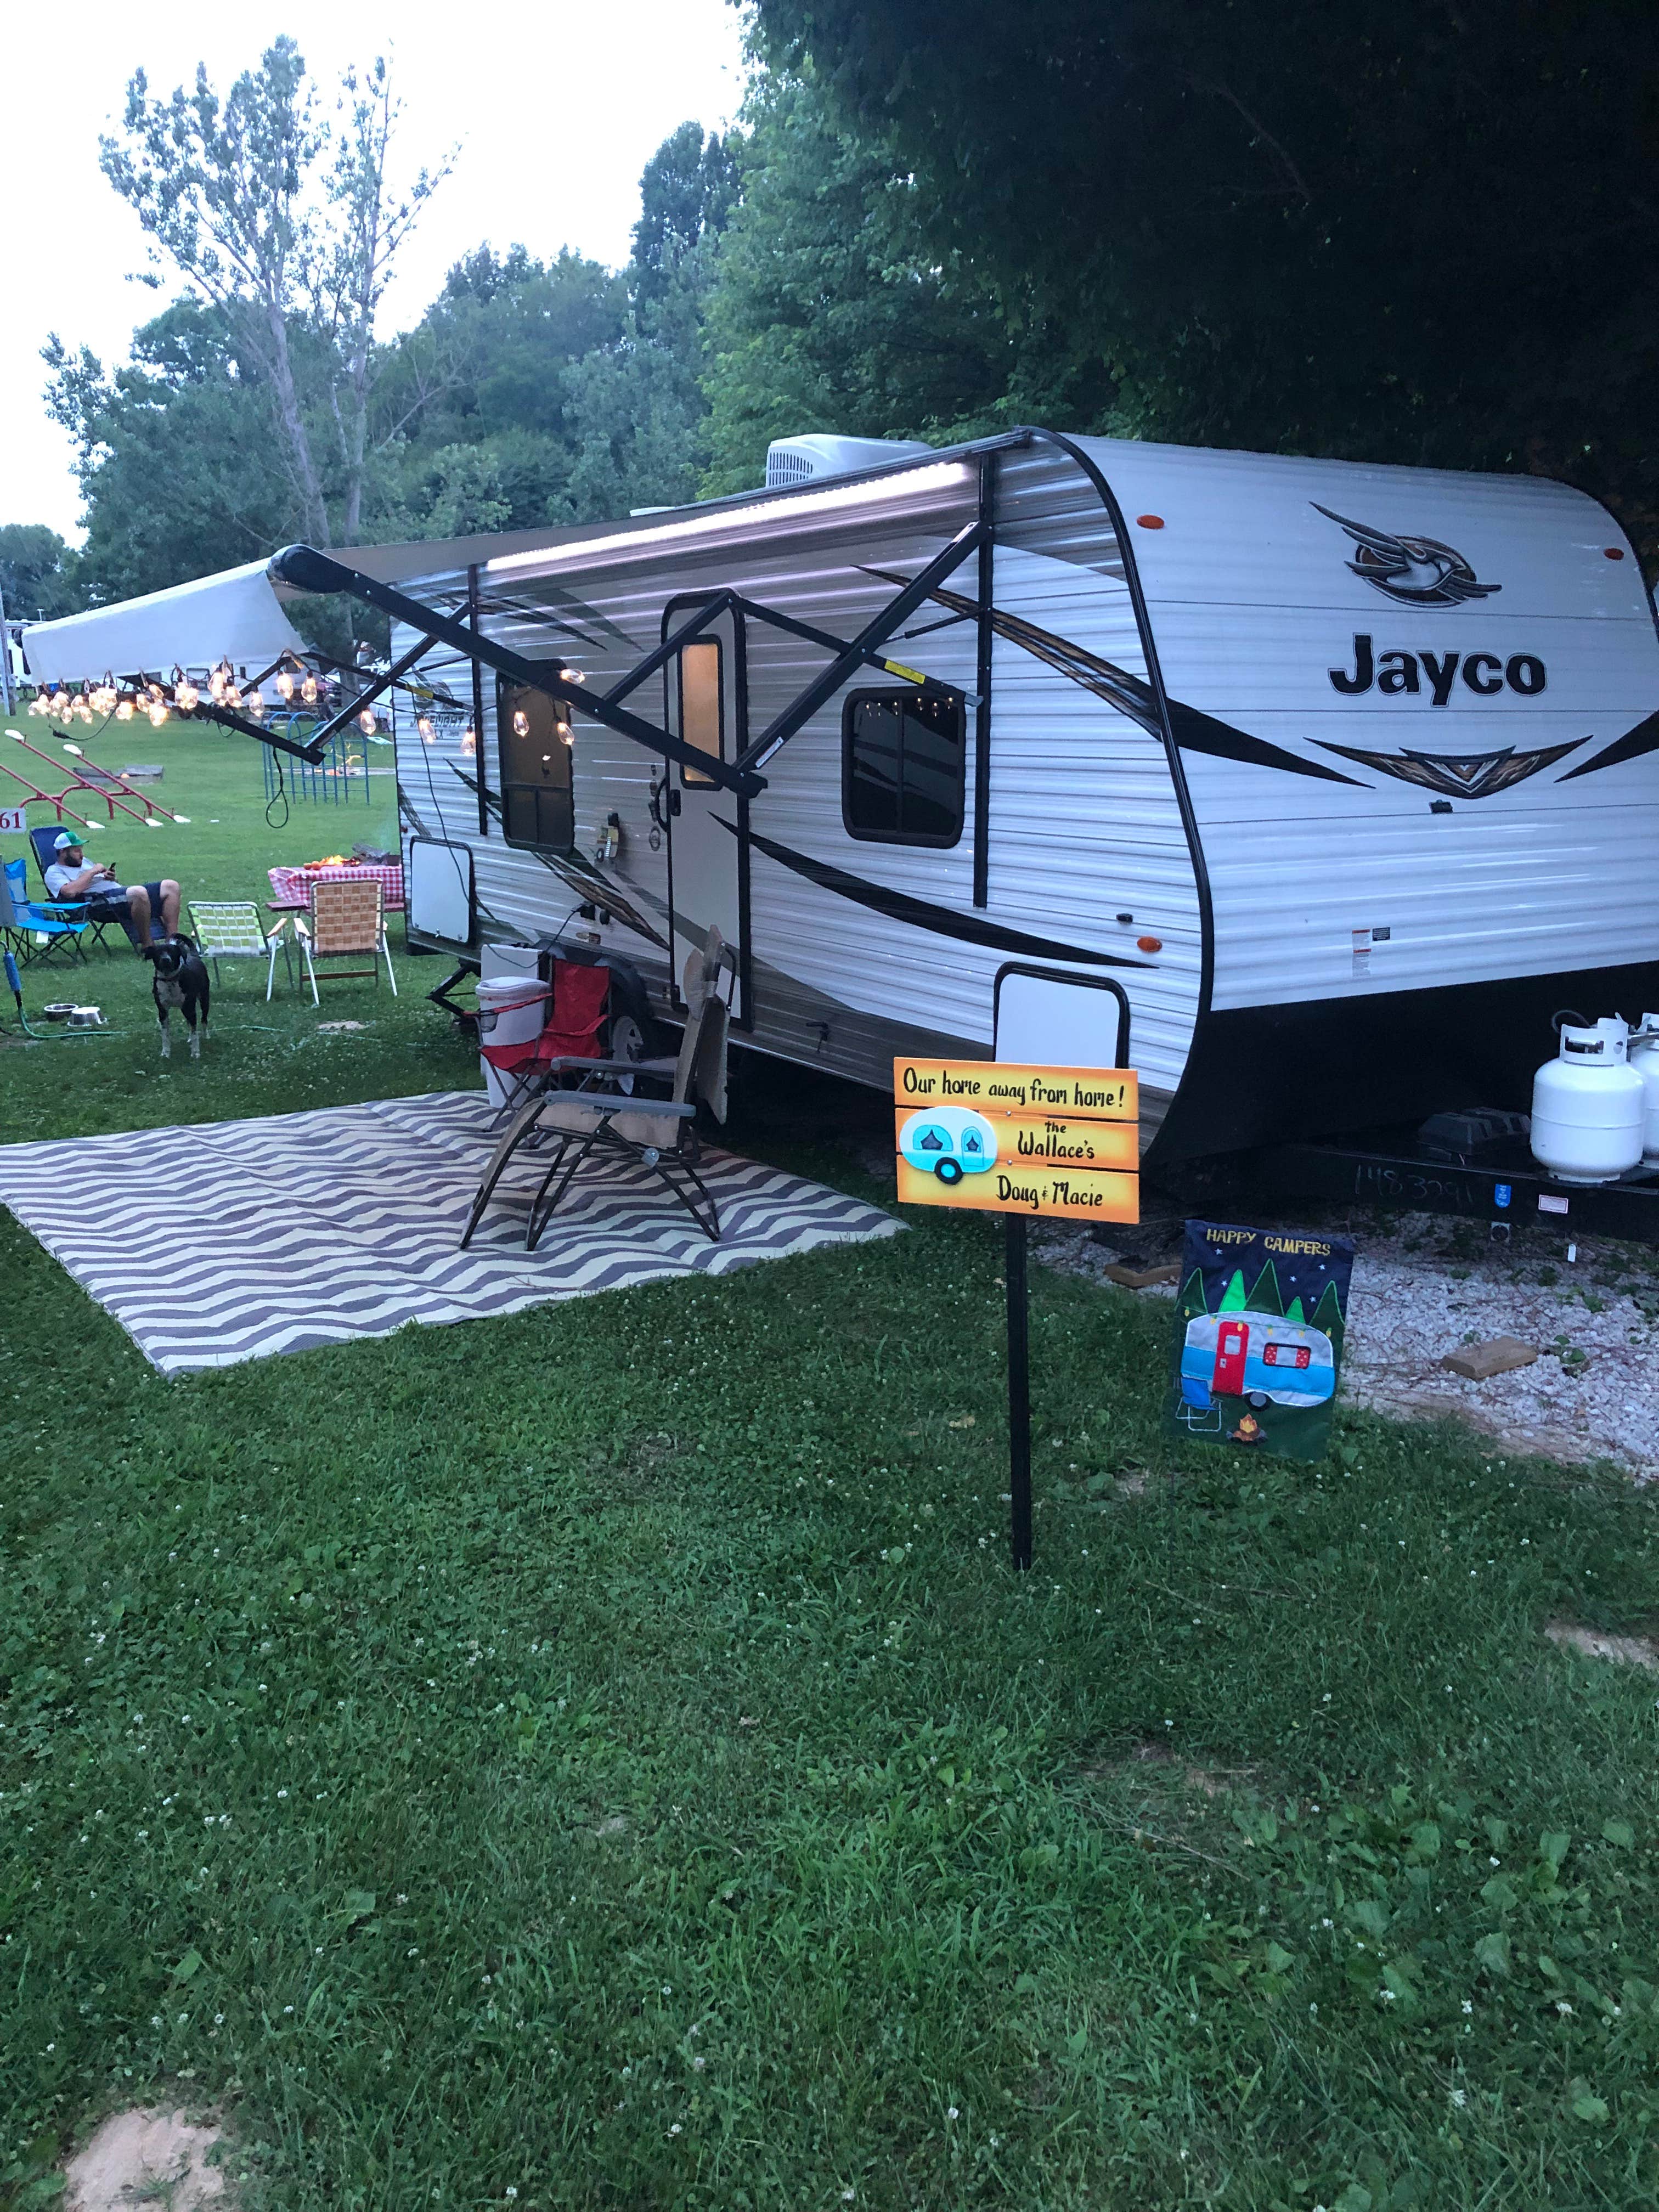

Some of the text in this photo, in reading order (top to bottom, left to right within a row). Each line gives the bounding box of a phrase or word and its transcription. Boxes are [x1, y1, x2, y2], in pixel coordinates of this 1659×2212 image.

[1328, 633, 1547, 707] Jayco
[0, 811, 22, 828] 61
[903, 1067, 936, 1093] Our
[942, 1070, 981, 1094] home
[988, 1084, 1025, 1105] away
[1030, 1078, 1067, 1104] from
[1045, 1121, 1067, 1133] the
[1018, 1130, 1095, 1159] Wallace's
[996, 1175, 1039, 1210] Doug
[1052, 1181, 1103, 1206] Macie
[1206, 1228, 1331, 1256] HAPPY CAMPERS
